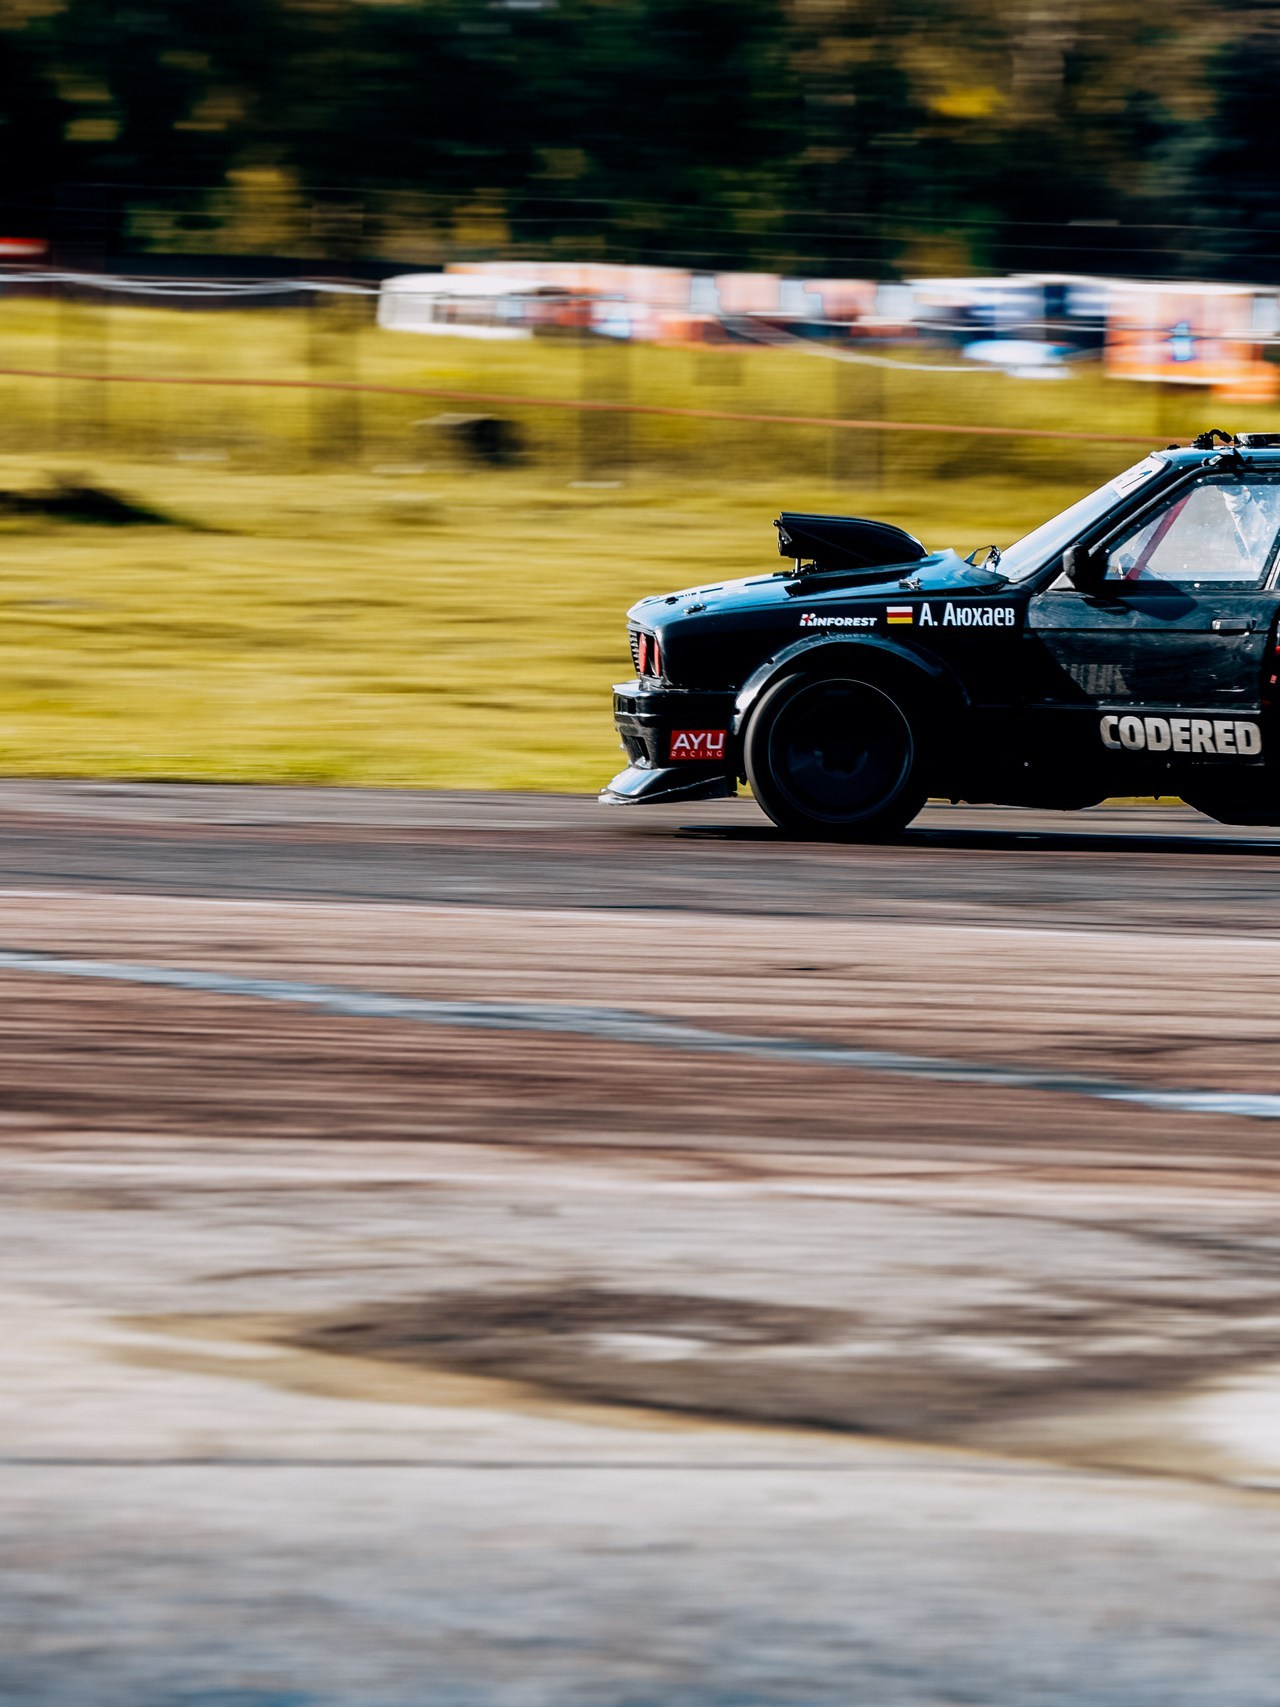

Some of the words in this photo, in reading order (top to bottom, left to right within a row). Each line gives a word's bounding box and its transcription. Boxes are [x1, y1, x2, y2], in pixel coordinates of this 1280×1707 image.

[799, 612, 878, 627] KINFOREST
[918, 602, 938, 627] А.
[942, 602, 1015, 627] Аюхаев
[672, 732, 725, 750] AYU
[1099, 714, 1263, 756] CODERED
[671, 750, 723, 758] RACING
